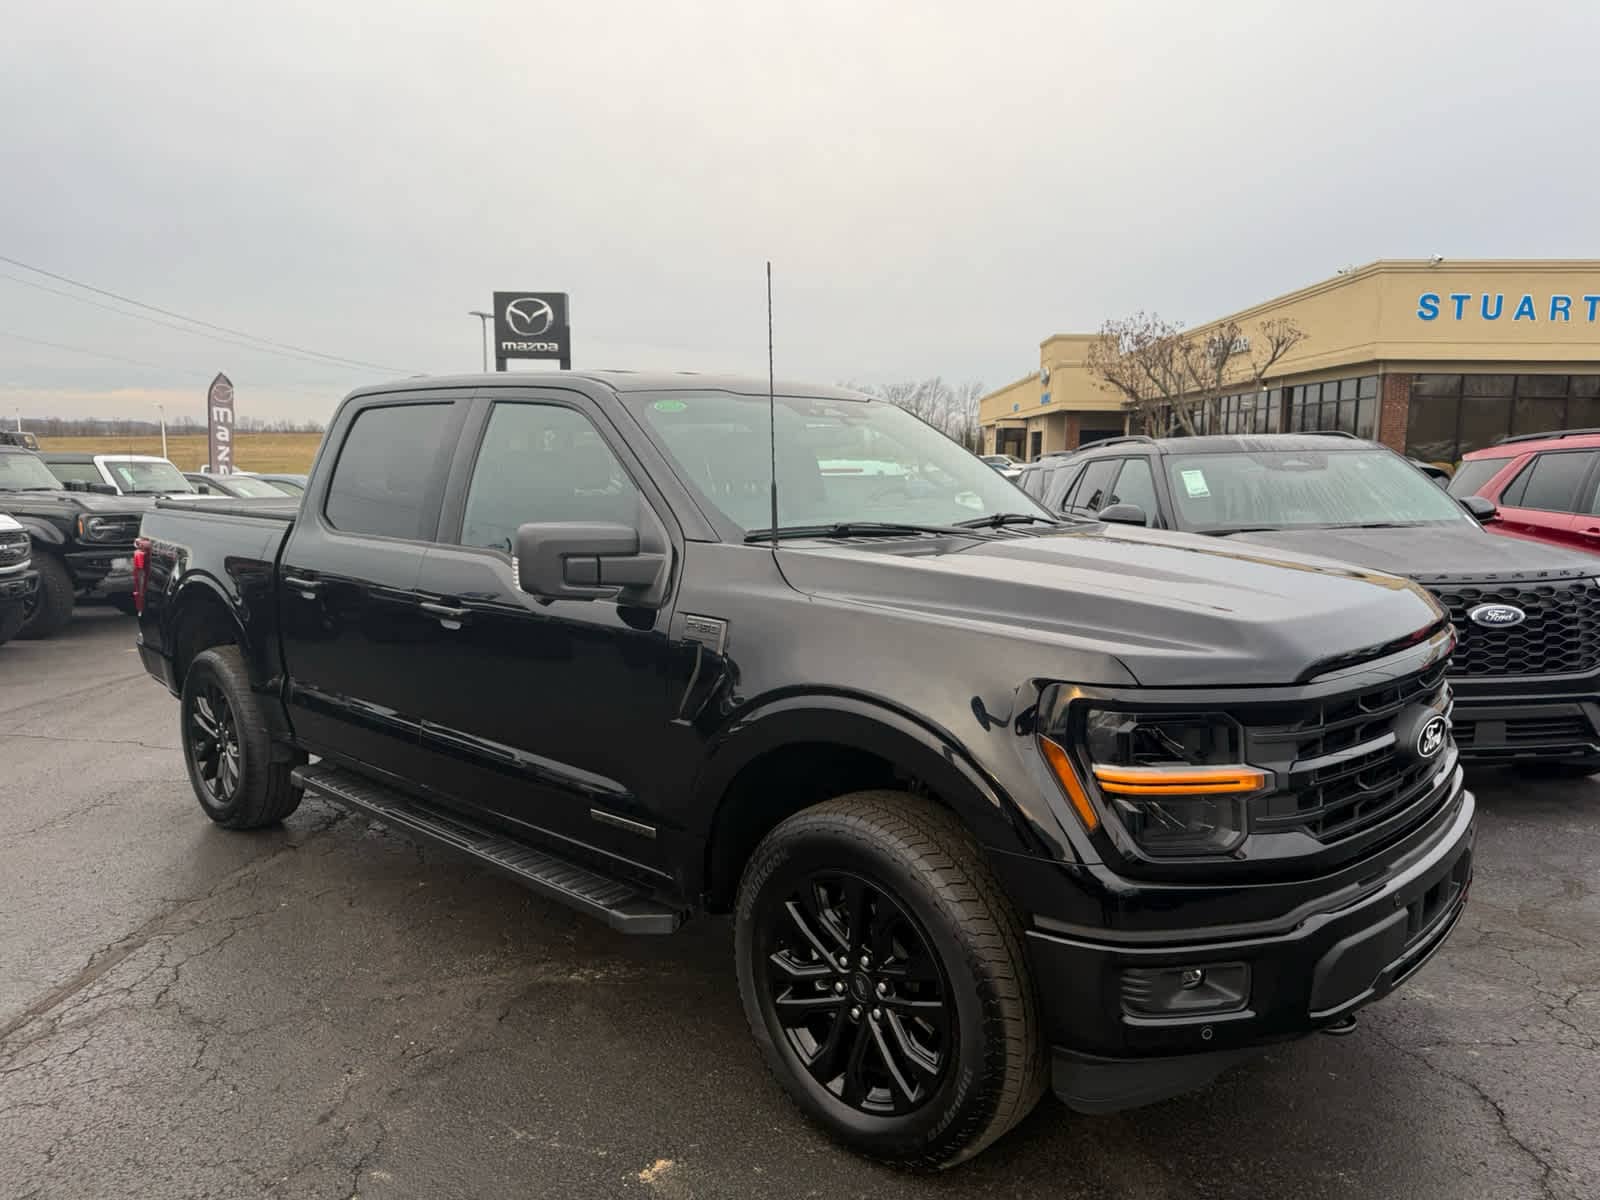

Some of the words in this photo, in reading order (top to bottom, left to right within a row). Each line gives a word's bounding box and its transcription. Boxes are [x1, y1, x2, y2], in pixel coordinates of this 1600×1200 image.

[1416, 293, 1600, 322] STUART
[501, 341, 559, 352] mazda
[1484, 607, 1515, 623] Ford
[1423, 721, 1443, 753] Ford
